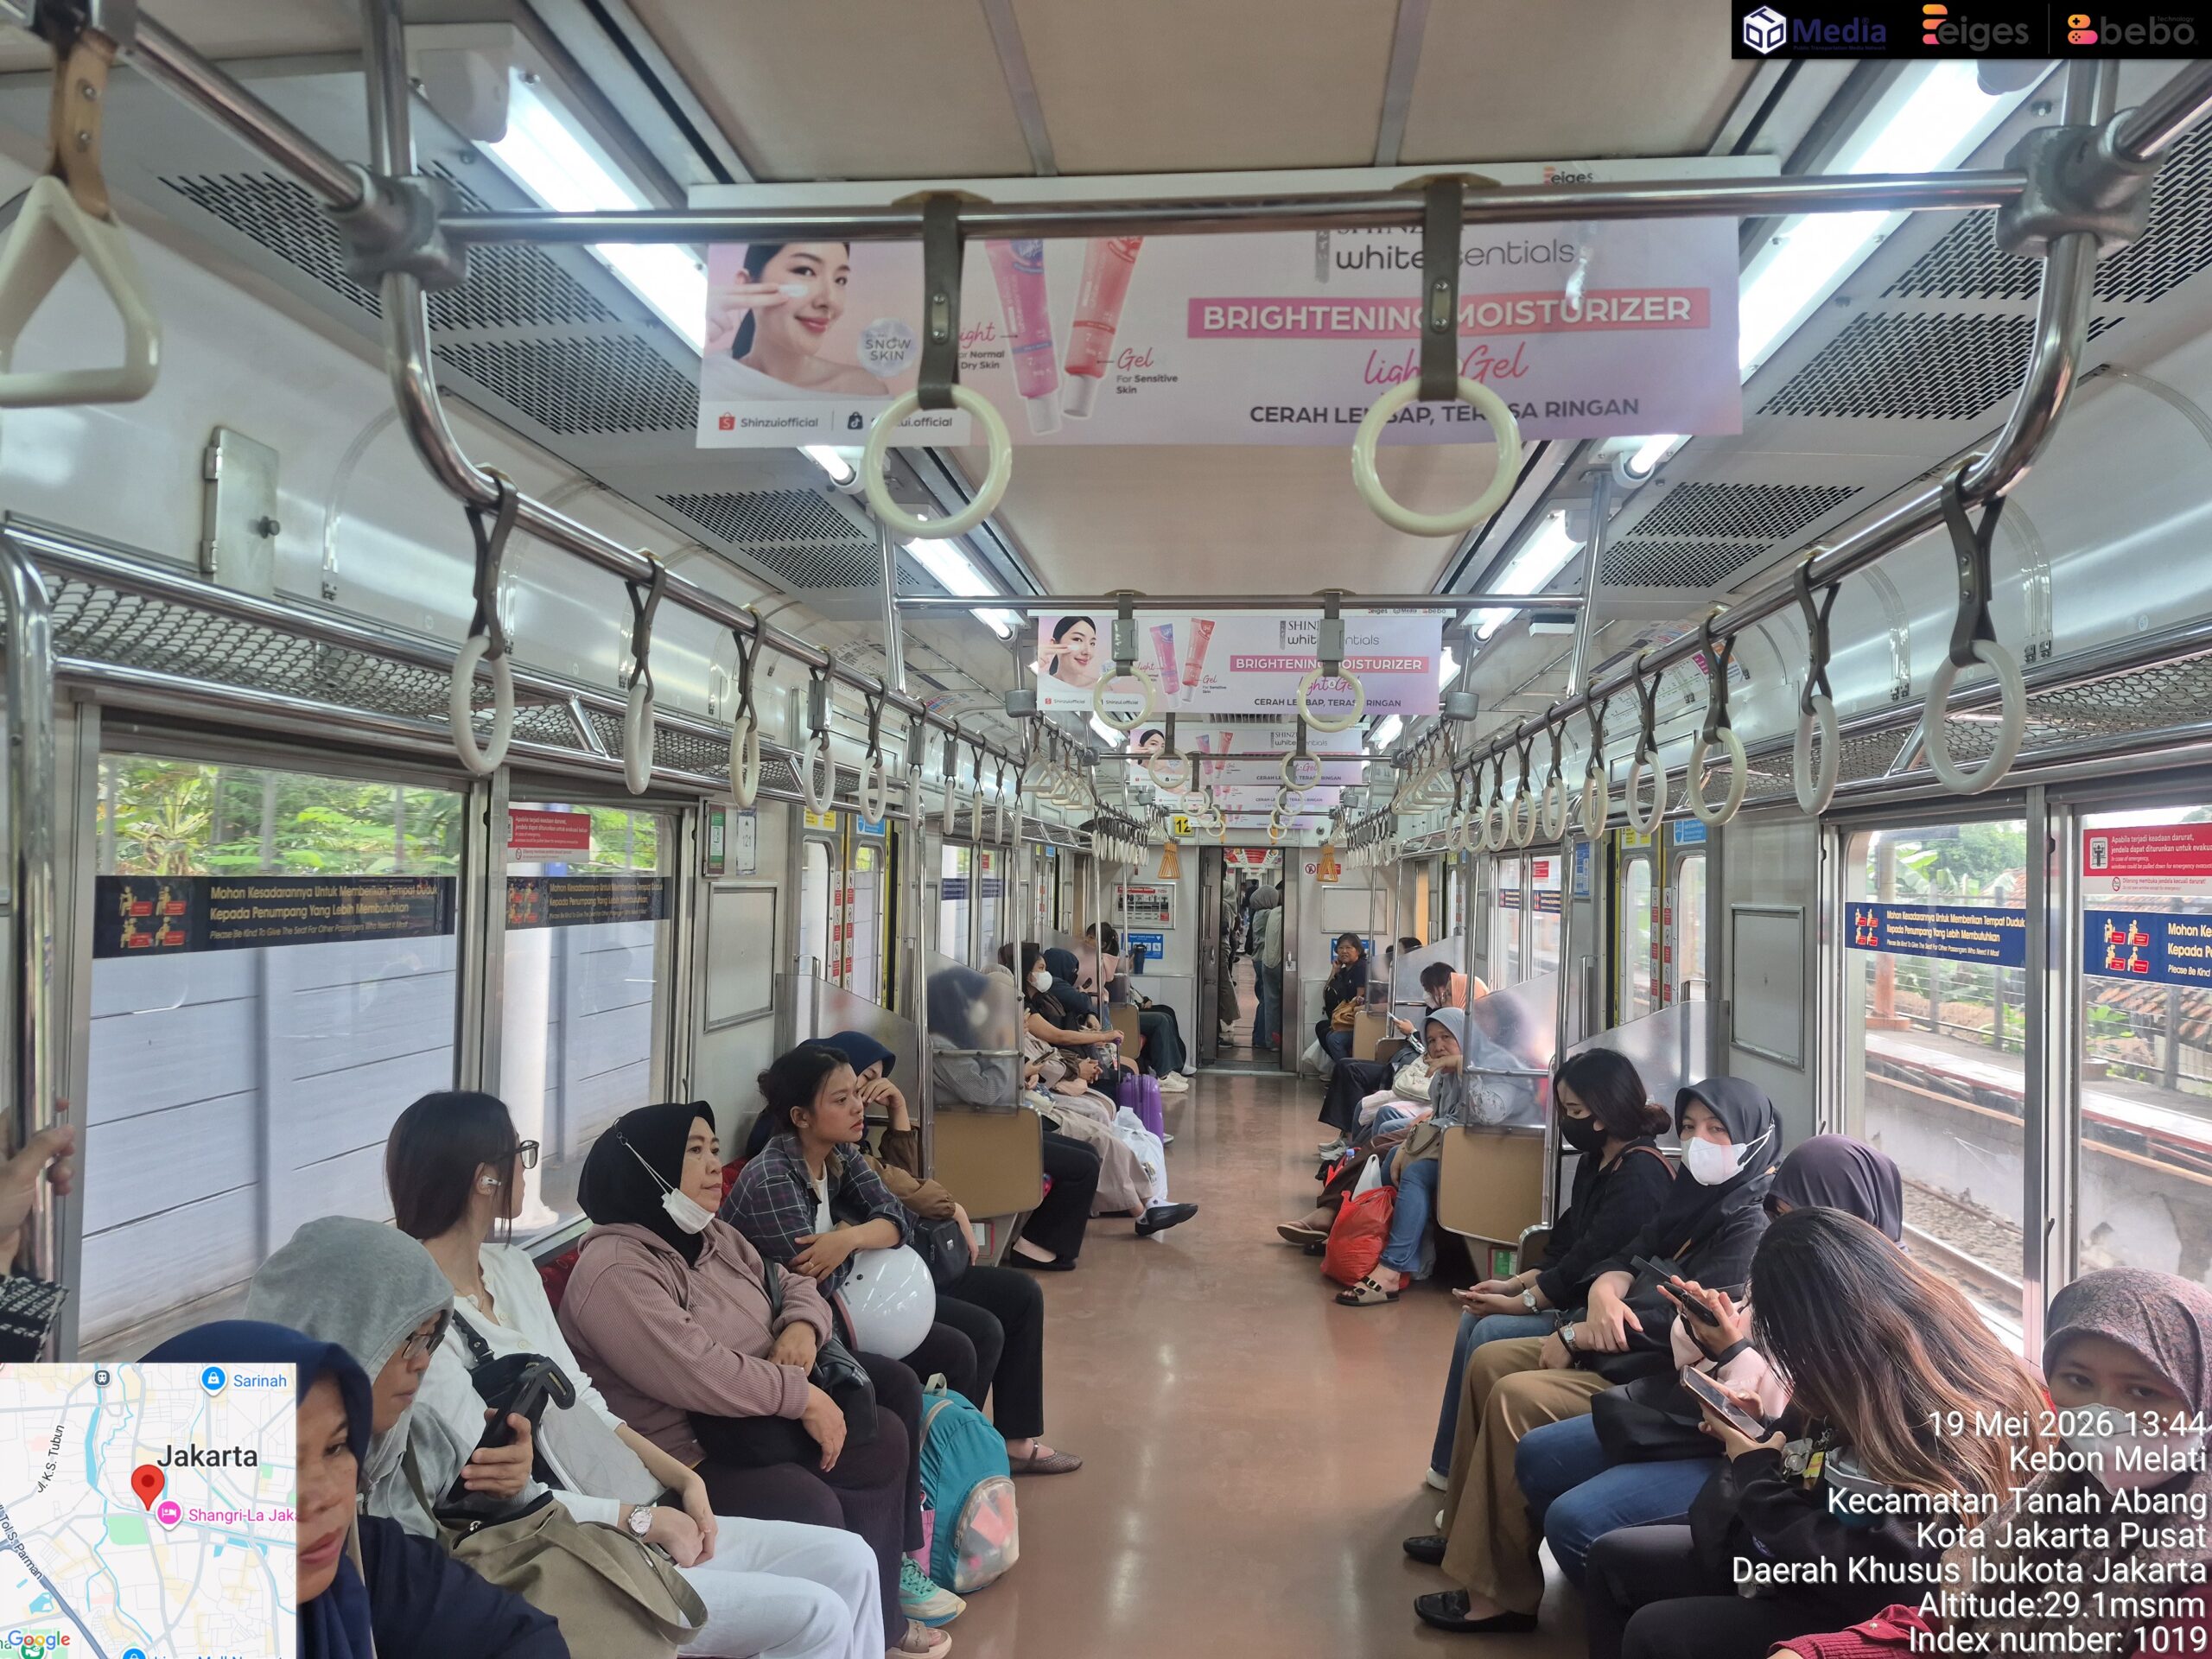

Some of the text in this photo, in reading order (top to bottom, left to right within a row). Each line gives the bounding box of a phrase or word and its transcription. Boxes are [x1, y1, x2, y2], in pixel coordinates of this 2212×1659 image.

[958, 322, 996, 349] ight
[865, 337, 912, 351] SNOW
[870, 351, 906, 361] SKIN
[969, 350, 1006, 359] Normal
[1116, 347, 1154, 372] Gel
[960, 360, 1001, 372] Dry Skin
[1116, 373, 1179, 384] For Sensitive
[1116, 385, 1137, 395] Skin
[1250, 405, 1328, 424] CERAH
[1545, 398, 1639, 418] RINGAN
[741, 416, 819, 429] Shinzuiofficial
[1288, 620, 1319, 631] SHIN
[1340, 658, 1422, 671] OISTURIZER
[1254, 698, 1402, 708] CERAH LEBAP, RINGAN
[2131, 834, 2147, 843] terjadi
[2130, 845, 2145, 854] dapat
[2175, 843, 2192, 852] untuk
[210, 886, 246, 899] Mohon
[247, 886, 314, 901] Kesadarannya
[314, 885, 338, 898] Untuk
[209, 907, 250, 923] Kepada
[251, 906, 308, 921] Penumpang
[308, 904, 331, 918] Yang
[332, 903, 354, 916] Lebih
[1949, 912, 1982, 925] Memberikan
[1983, 914, 2005, 928] Tempat
[2005, 915, 2026, 928] Duduk
[1904, 925, 1932, 938] Penumpang
[1932, 927, 1946, 940] Yang
[1946, 928, 1961, 939] Lebih
[1961, 929, 2000, 943] Membutuhkan
[2168, 922, 2198, 937] Mohon
[2167, 942, 2203, 958] Kepada
[2167, 963, 2210, 977] Please Be Kind
